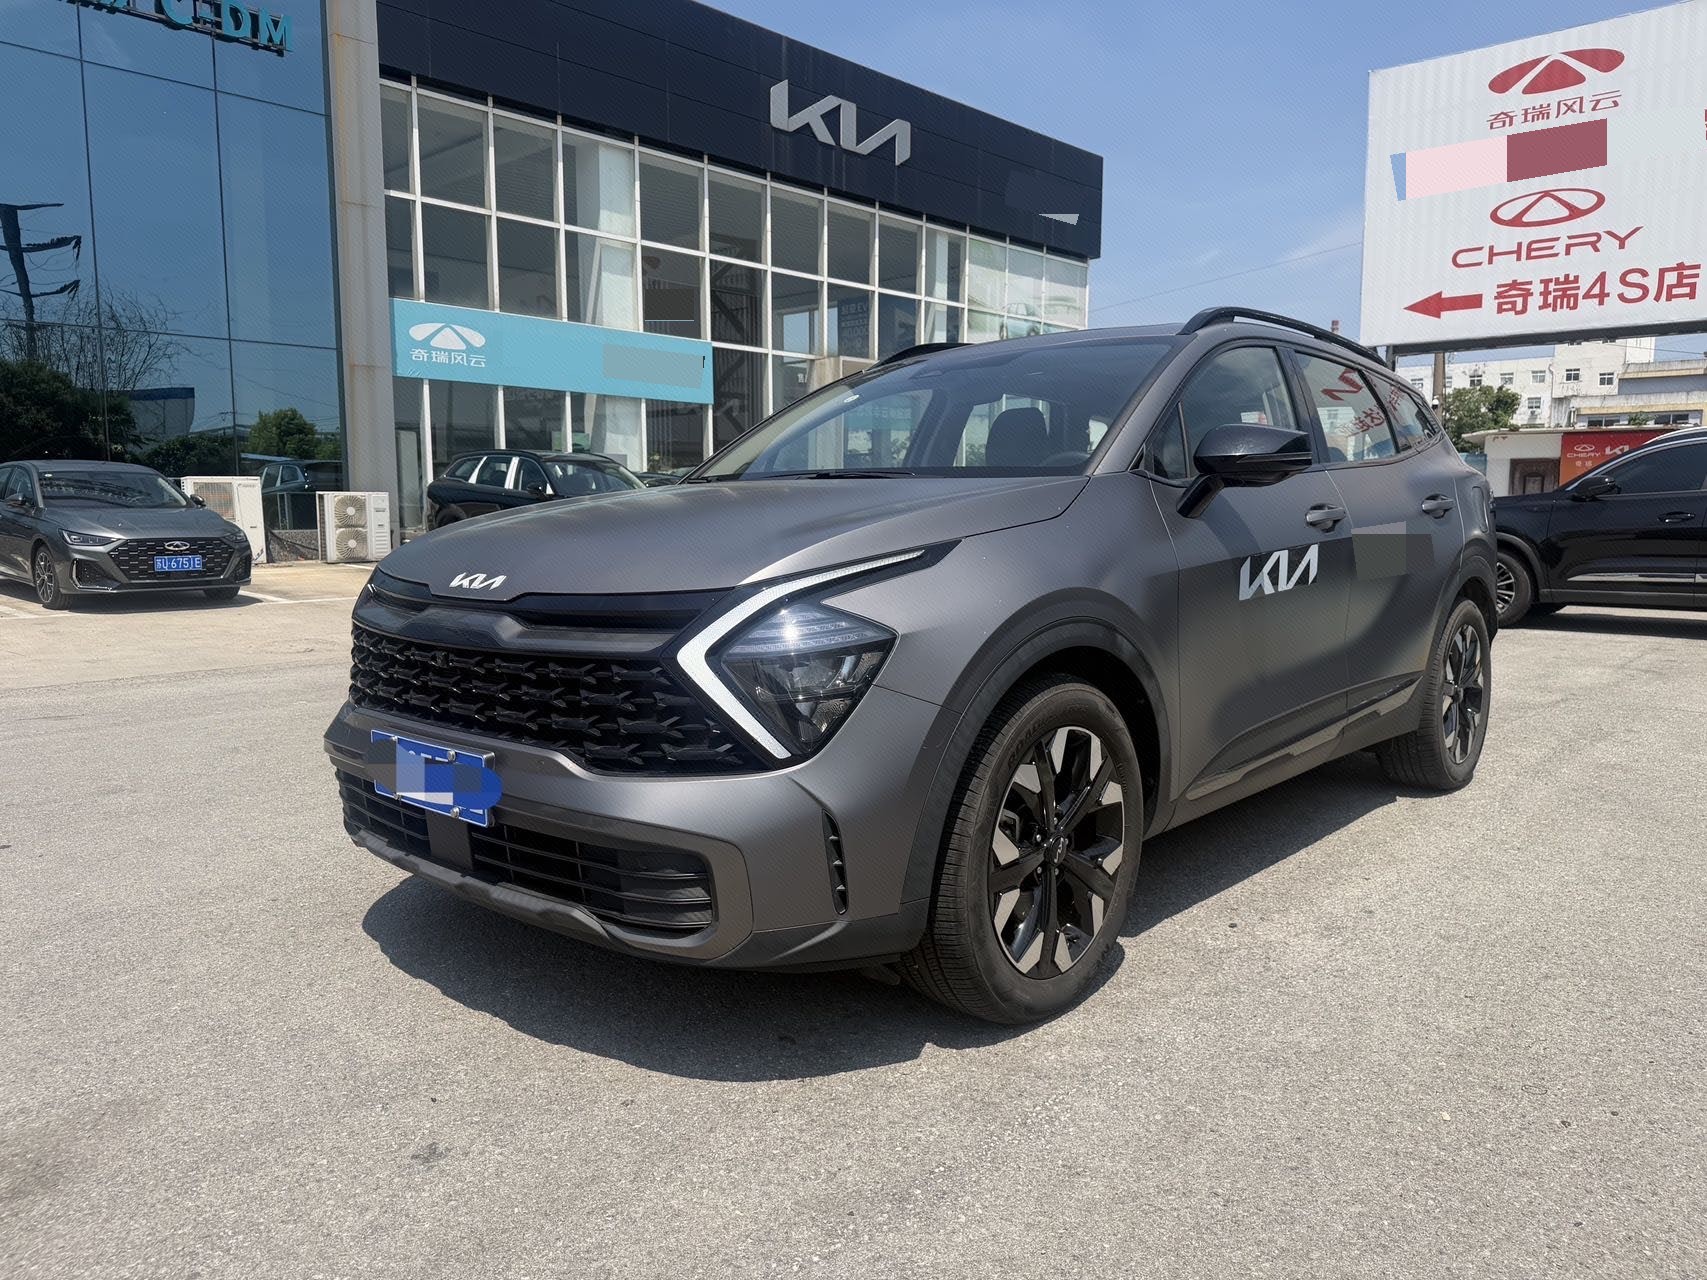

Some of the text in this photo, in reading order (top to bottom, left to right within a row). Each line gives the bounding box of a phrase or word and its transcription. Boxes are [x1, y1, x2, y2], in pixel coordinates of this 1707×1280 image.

[769, 79, 912, 167] KIA
[1486, 90, 1623, 131] 奇瑞风云
[1451, 226, 1645, 269] CHERY
[1493, 261, 1702, 316] 奇瑞4S店
[410, 348, 487, 368] 奇瑞风云
[1605, 444, 1630, 457] KI
[448, 571, 507, 591] KIA
[1238, 543, 1319, 601] KIA
